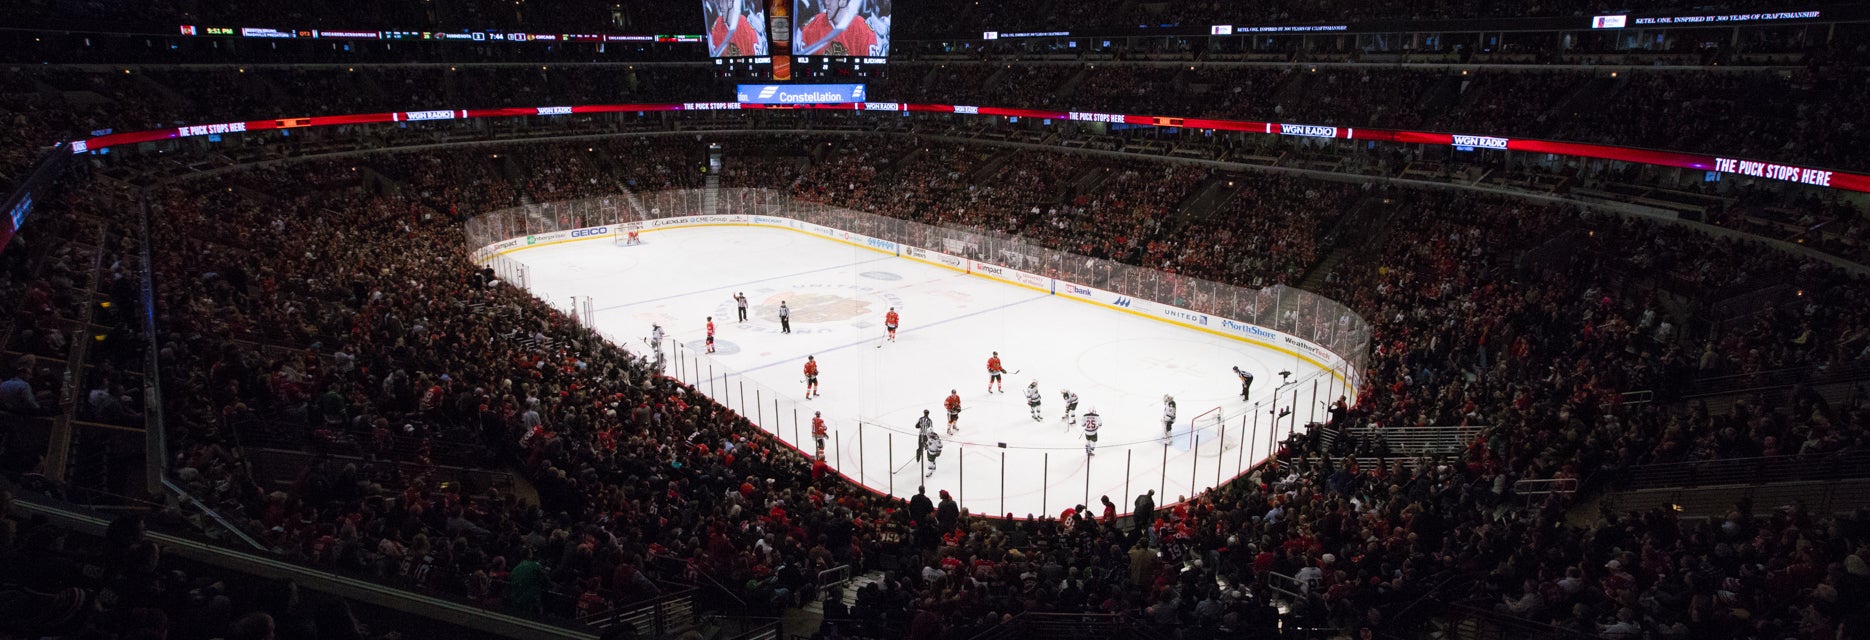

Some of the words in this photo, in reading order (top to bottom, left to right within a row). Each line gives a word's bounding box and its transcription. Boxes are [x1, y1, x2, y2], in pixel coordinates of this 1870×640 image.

[1069, 112, 1079, 120] THE
[1080, 112, 1092, 122] PUCK
[1094, 113, 1110, 122] STOPS
[1111, 114, 1124, 123] HERE
[179, 127, 190, 137] THE
[190, 126, 208, 135] PUCK
[209, 124, 228, 134] STOPS
[230, 122, 246, 133] HERE
[1282, 125, 1303, 134] WGN
[1305, 126, 1333, 136] RADIO
[1455, 136, 1478, 146] WGN
[1480, 137, 1507, 148] RADIO
[1715, 158, 1737, 173] THE
[1738, 161, 1764, 177] PUCK
[1766, 164, 1800, 182] STOPS
[1801, 169, 1832, 186] HERE
[571, 227, 607, 238] GEICO
[1074, 286, 1091, 296] bank
[1165, 309, 1197, 321] UNITED
[1228, 320, 1276, 340] NorthShore
[1285, 336, 1330, 360] WeatherTech
[1086, 420, 1095, 429] 25
